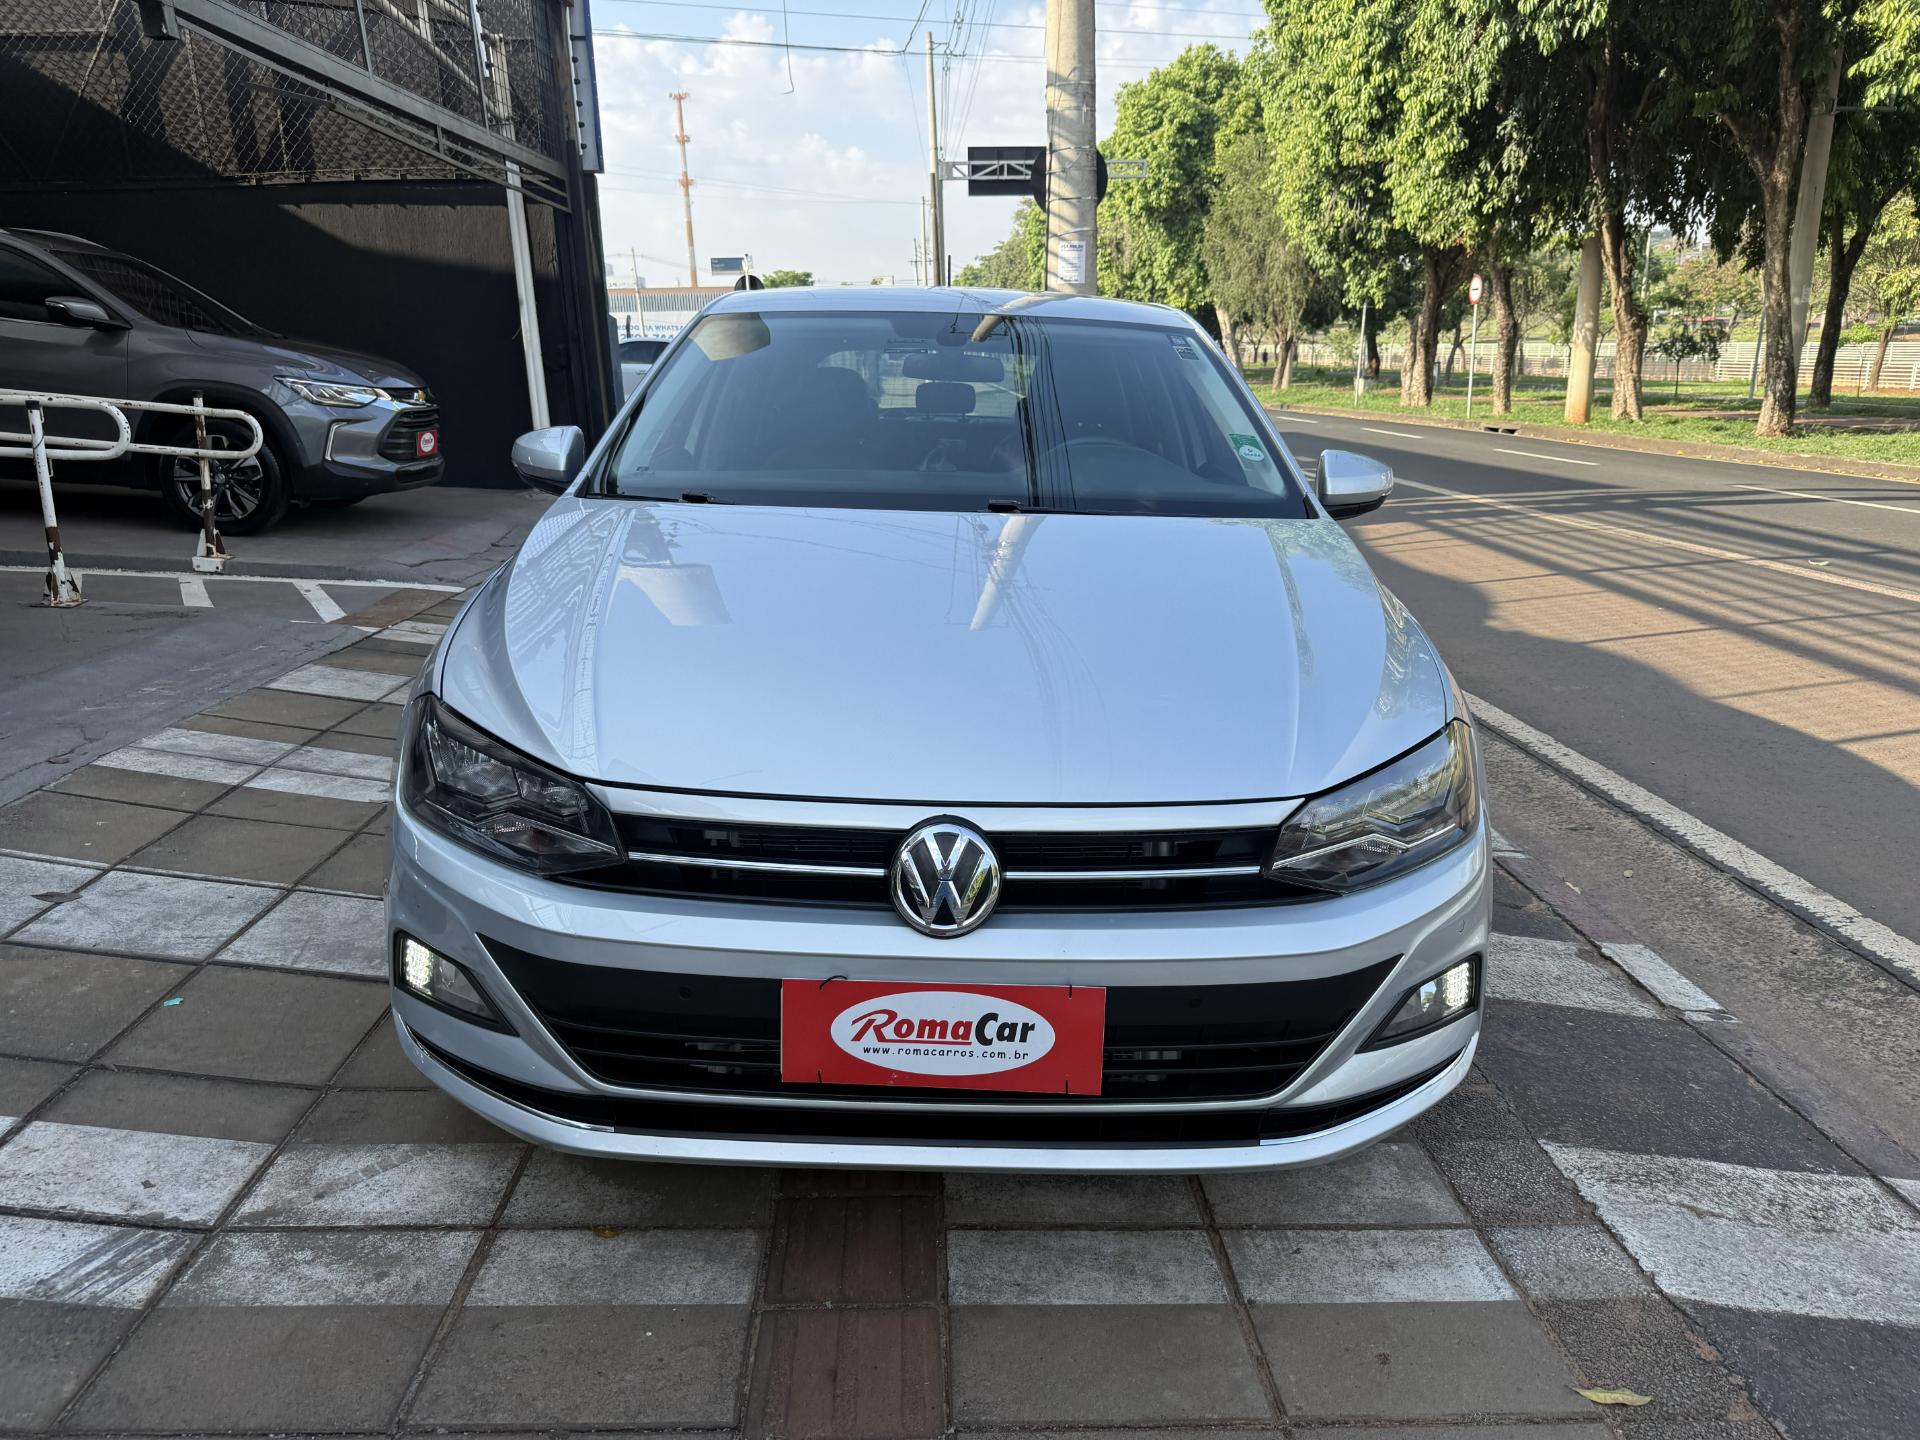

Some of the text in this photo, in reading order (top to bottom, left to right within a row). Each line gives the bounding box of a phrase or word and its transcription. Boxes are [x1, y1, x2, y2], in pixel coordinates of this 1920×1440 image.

[891, 823, 1001, 938] VW
[851, 1009, 1035, 1046] RomaCar
[863, 1046, 1029, 1060] www.romacarros.com.br
